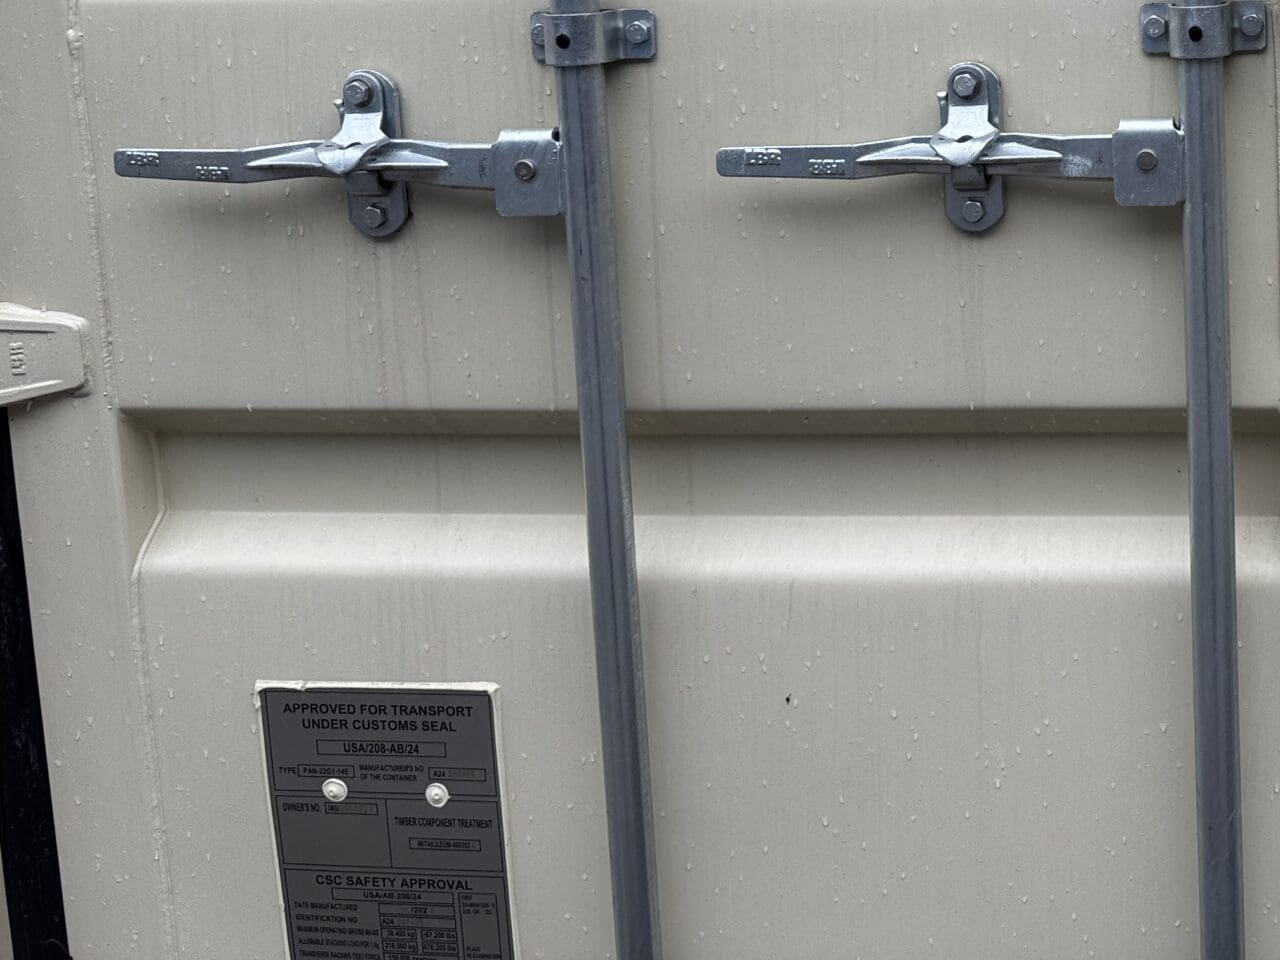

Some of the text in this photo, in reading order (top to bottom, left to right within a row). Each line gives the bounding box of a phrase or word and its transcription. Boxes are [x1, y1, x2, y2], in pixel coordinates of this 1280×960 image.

[283, 703, 472, 717] APPROVED FOR TRANSPORT
[303, 719, 456, 732] UNDER CUSTOMS SEAL
[343, 743, 419, 754] USA/208-AB/24
[395, 817, 492, 828] TIMBER COMPONENT TREATMENT
[316, 875, 473, 890] CSC SAFETY APPROVAL
